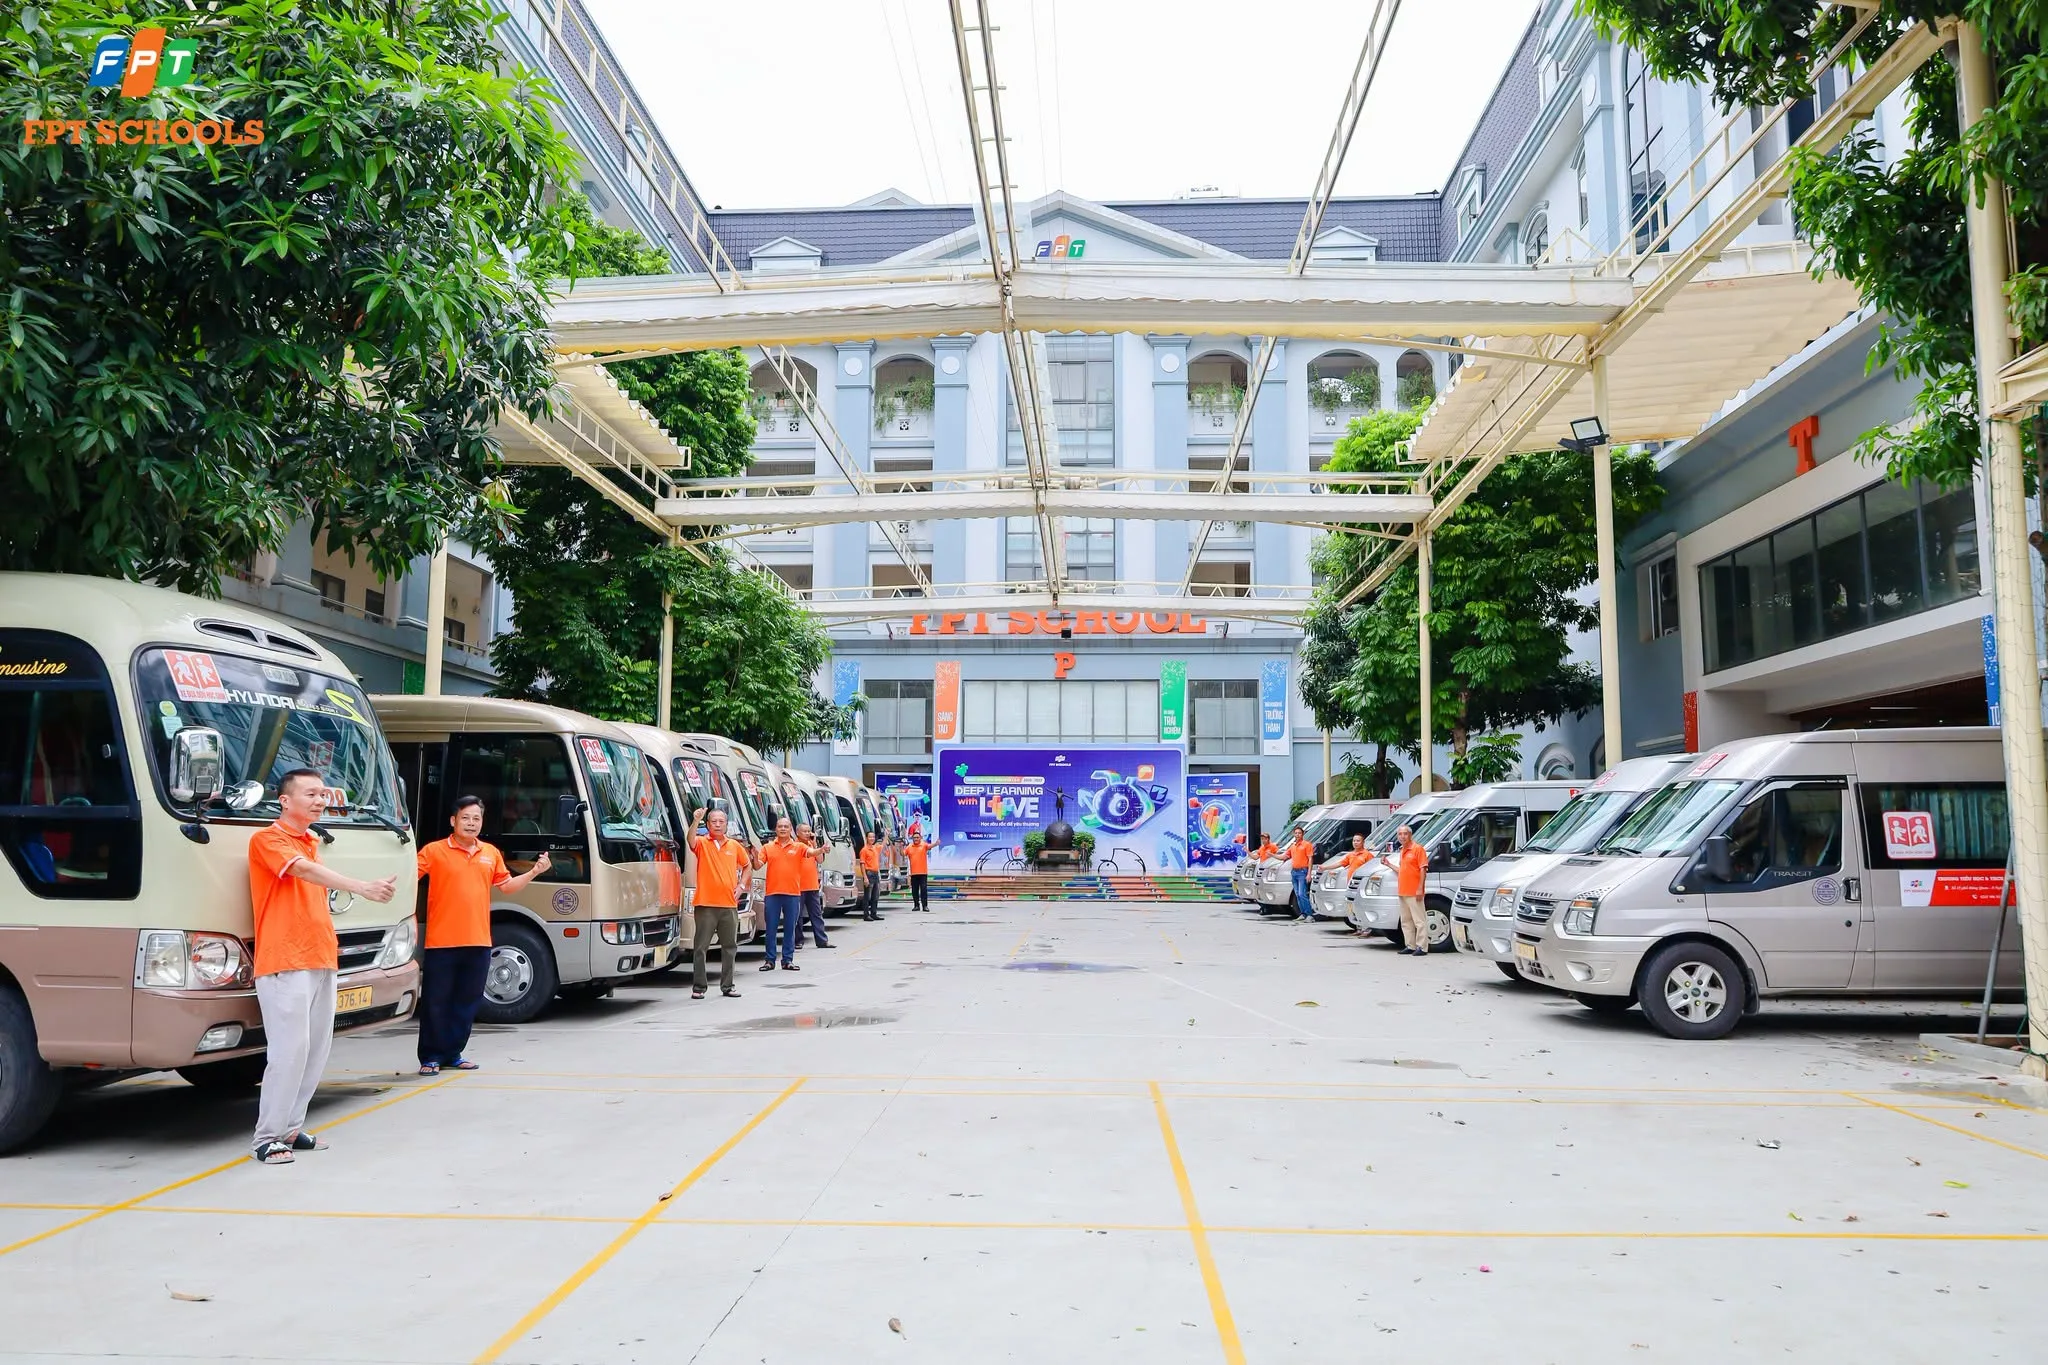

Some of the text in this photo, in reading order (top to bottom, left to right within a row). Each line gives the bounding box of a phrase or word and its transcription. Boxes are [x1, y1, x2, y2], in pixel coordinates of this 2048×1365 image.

[1789, 415, 1819, 475] T
[1054, 652, 1076, 679] P
[224, 689, 297, 710] HYUNDAI
[955, 787, 1044, 795] DEEP LEARNING
[957, 797, 1039, 818] with LVE
